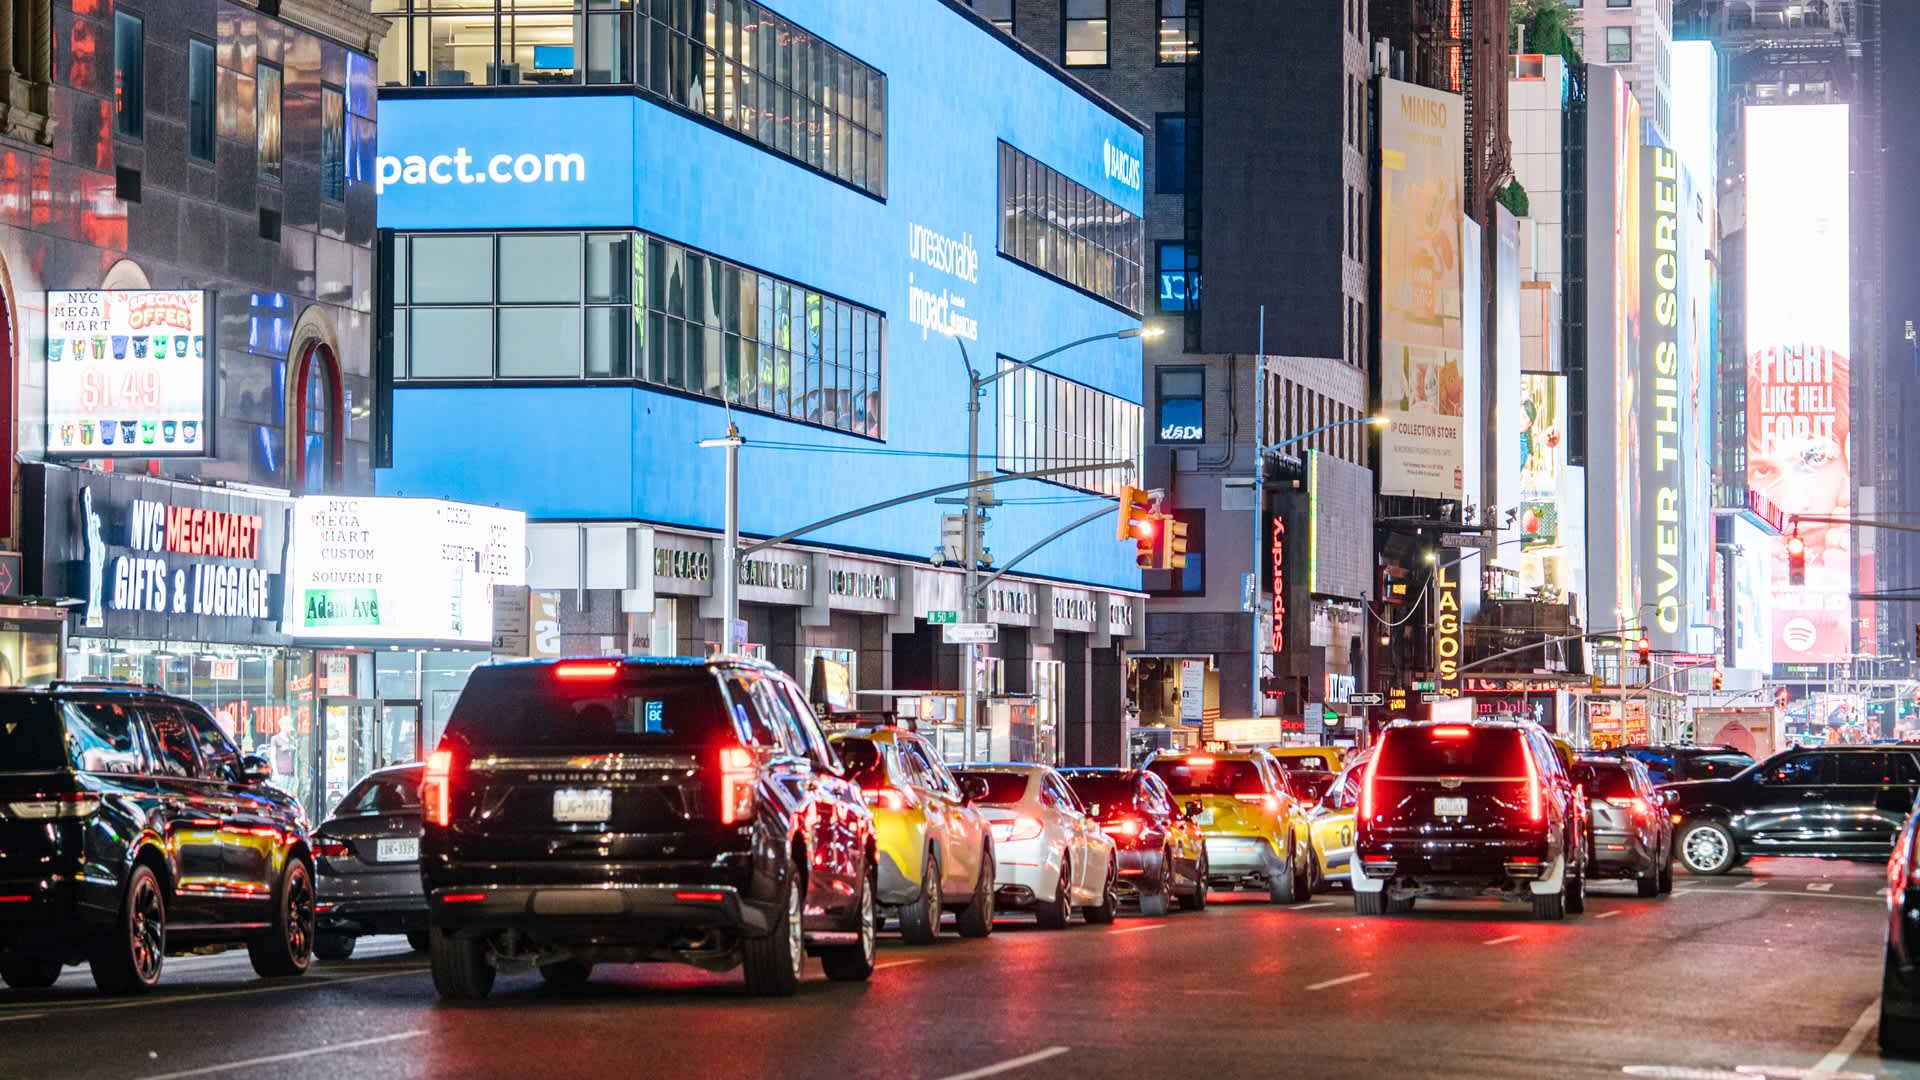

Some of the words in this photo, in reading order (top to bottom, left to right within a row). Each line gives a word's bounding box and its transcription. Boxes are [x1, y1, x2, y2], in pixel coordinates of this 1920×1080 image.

[1401, 94, 1447, 128] MINISO
[376, 148, 585, 194] pact.com
[1111, 145, 1140, 190] BARCLAYS
[909, 222, 978, 284] unreasonable
[68, 293, 98, 304] NYC
[55, 307, 100, 317] MEGA
[129, 306, 191, 331] OFFER
[65, 321, 110, 331] MART
[1761, 346, 1833, 383] FIGHT
[1655, 341, 1679, 471] THIS
[1761, 386, 1795, 412] LIKE
[1798, 386, 1836, 412] HELL
[1399, 423, 1436, 438] COLLECTION
[1438, 427, 1457, 440] STORE
[329, 501, 358, 513] NYC
[131, 499, 164, 553] NYC
[166, 504, 263, 560] MEGAMART
[315, 515, 360, 527] MEGA
[325, 530, 370, 542] MART
[1444, 535, 1474, 546] OUTFRONT
[321, 548, 375, 560] CUSTOM
[654, 547, 709, 581] CHICAGO
[1657, 486, 1679, 634] OVER
[114, 556, 167, 612] GIFTS
[172, 569, 186, 613] &
[193, 563, 269, 618] LUGGAGE
[312, 572, 383, 583] SOUVENIR
[830, 569, 896, 600] LONDON
[353, 599, 379, 620] Ave
[1439, 567, 1459, 680] LAGOS
[1496, 700, 1532, 713] Dolls
[1630, 733, 1646, 745] OFF
